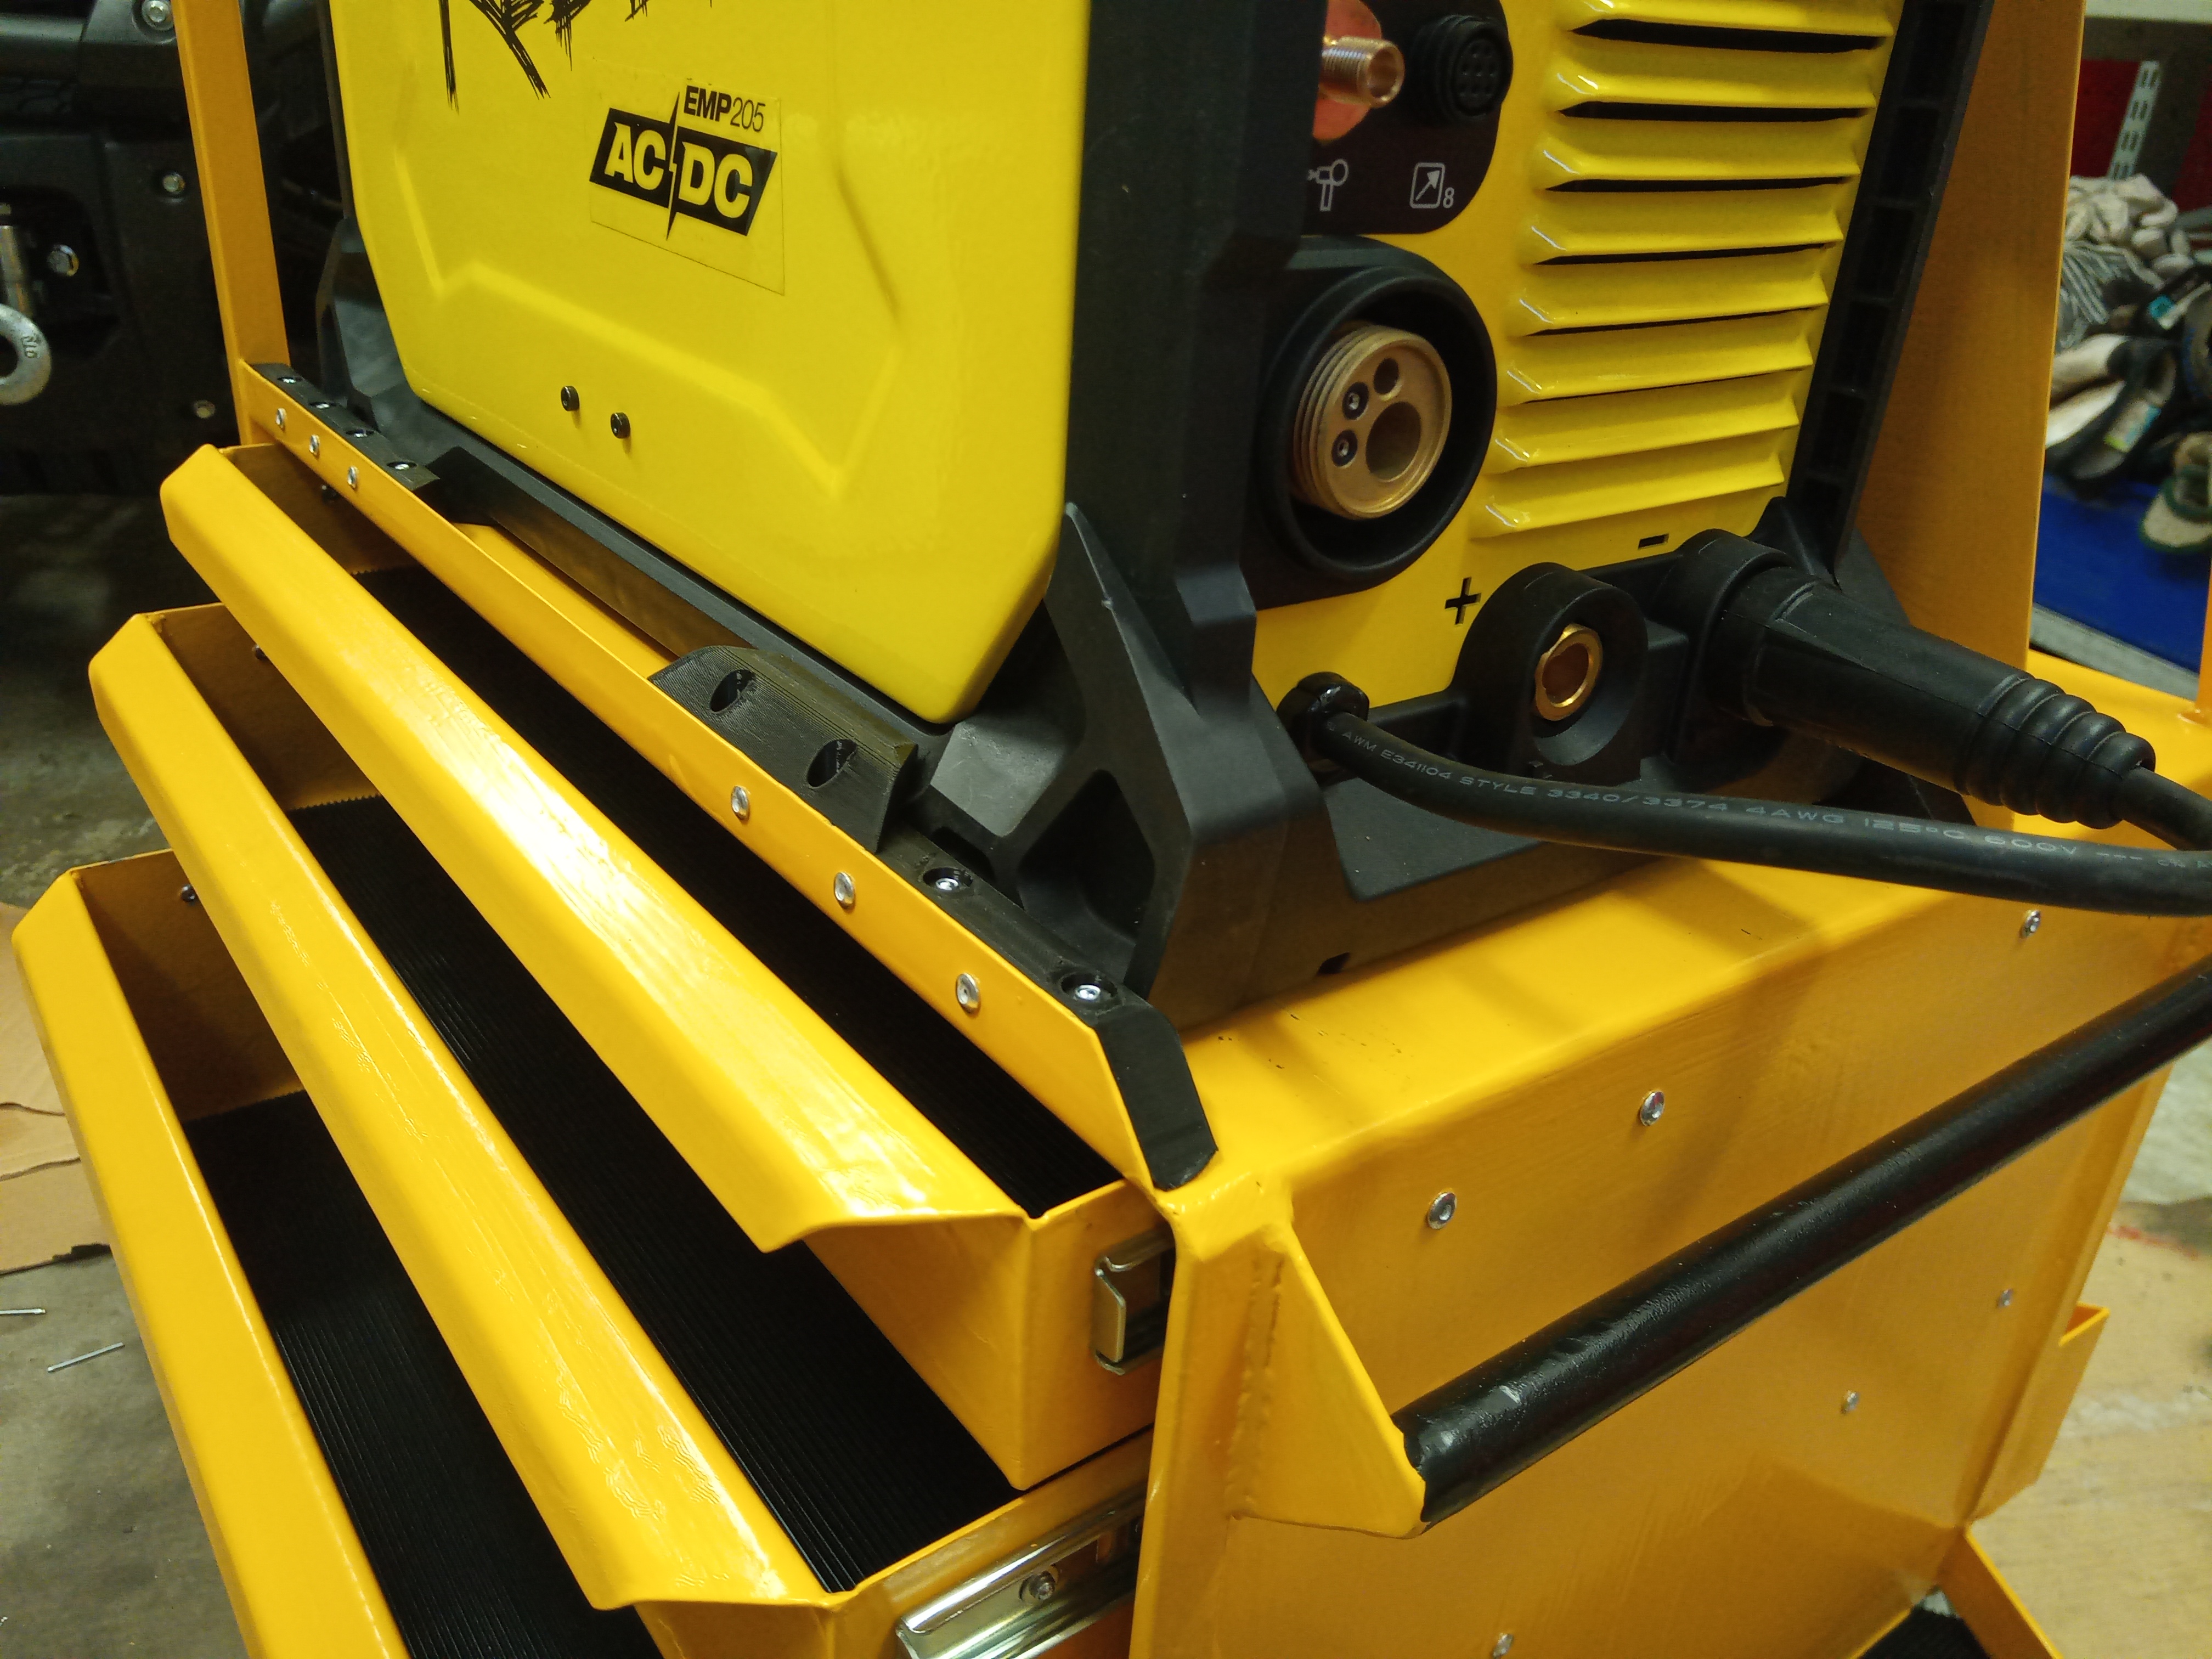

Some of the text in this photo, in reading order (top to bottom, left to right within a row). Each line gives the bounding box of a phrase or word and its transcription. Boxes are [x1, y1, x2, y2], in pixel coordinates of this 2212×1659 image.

[684, 84, 766, 133] EMP205
[1442, 187, 1455, 209] 8
[1342, 731, 1378, 752] AWM
[1380, 748, 1453, 780] E341104
[1459, 776, 1537, 795] STYLE
[1746, 805, 1844, 823] 4AWG
[1984, 834, 2077, 856] 600V
